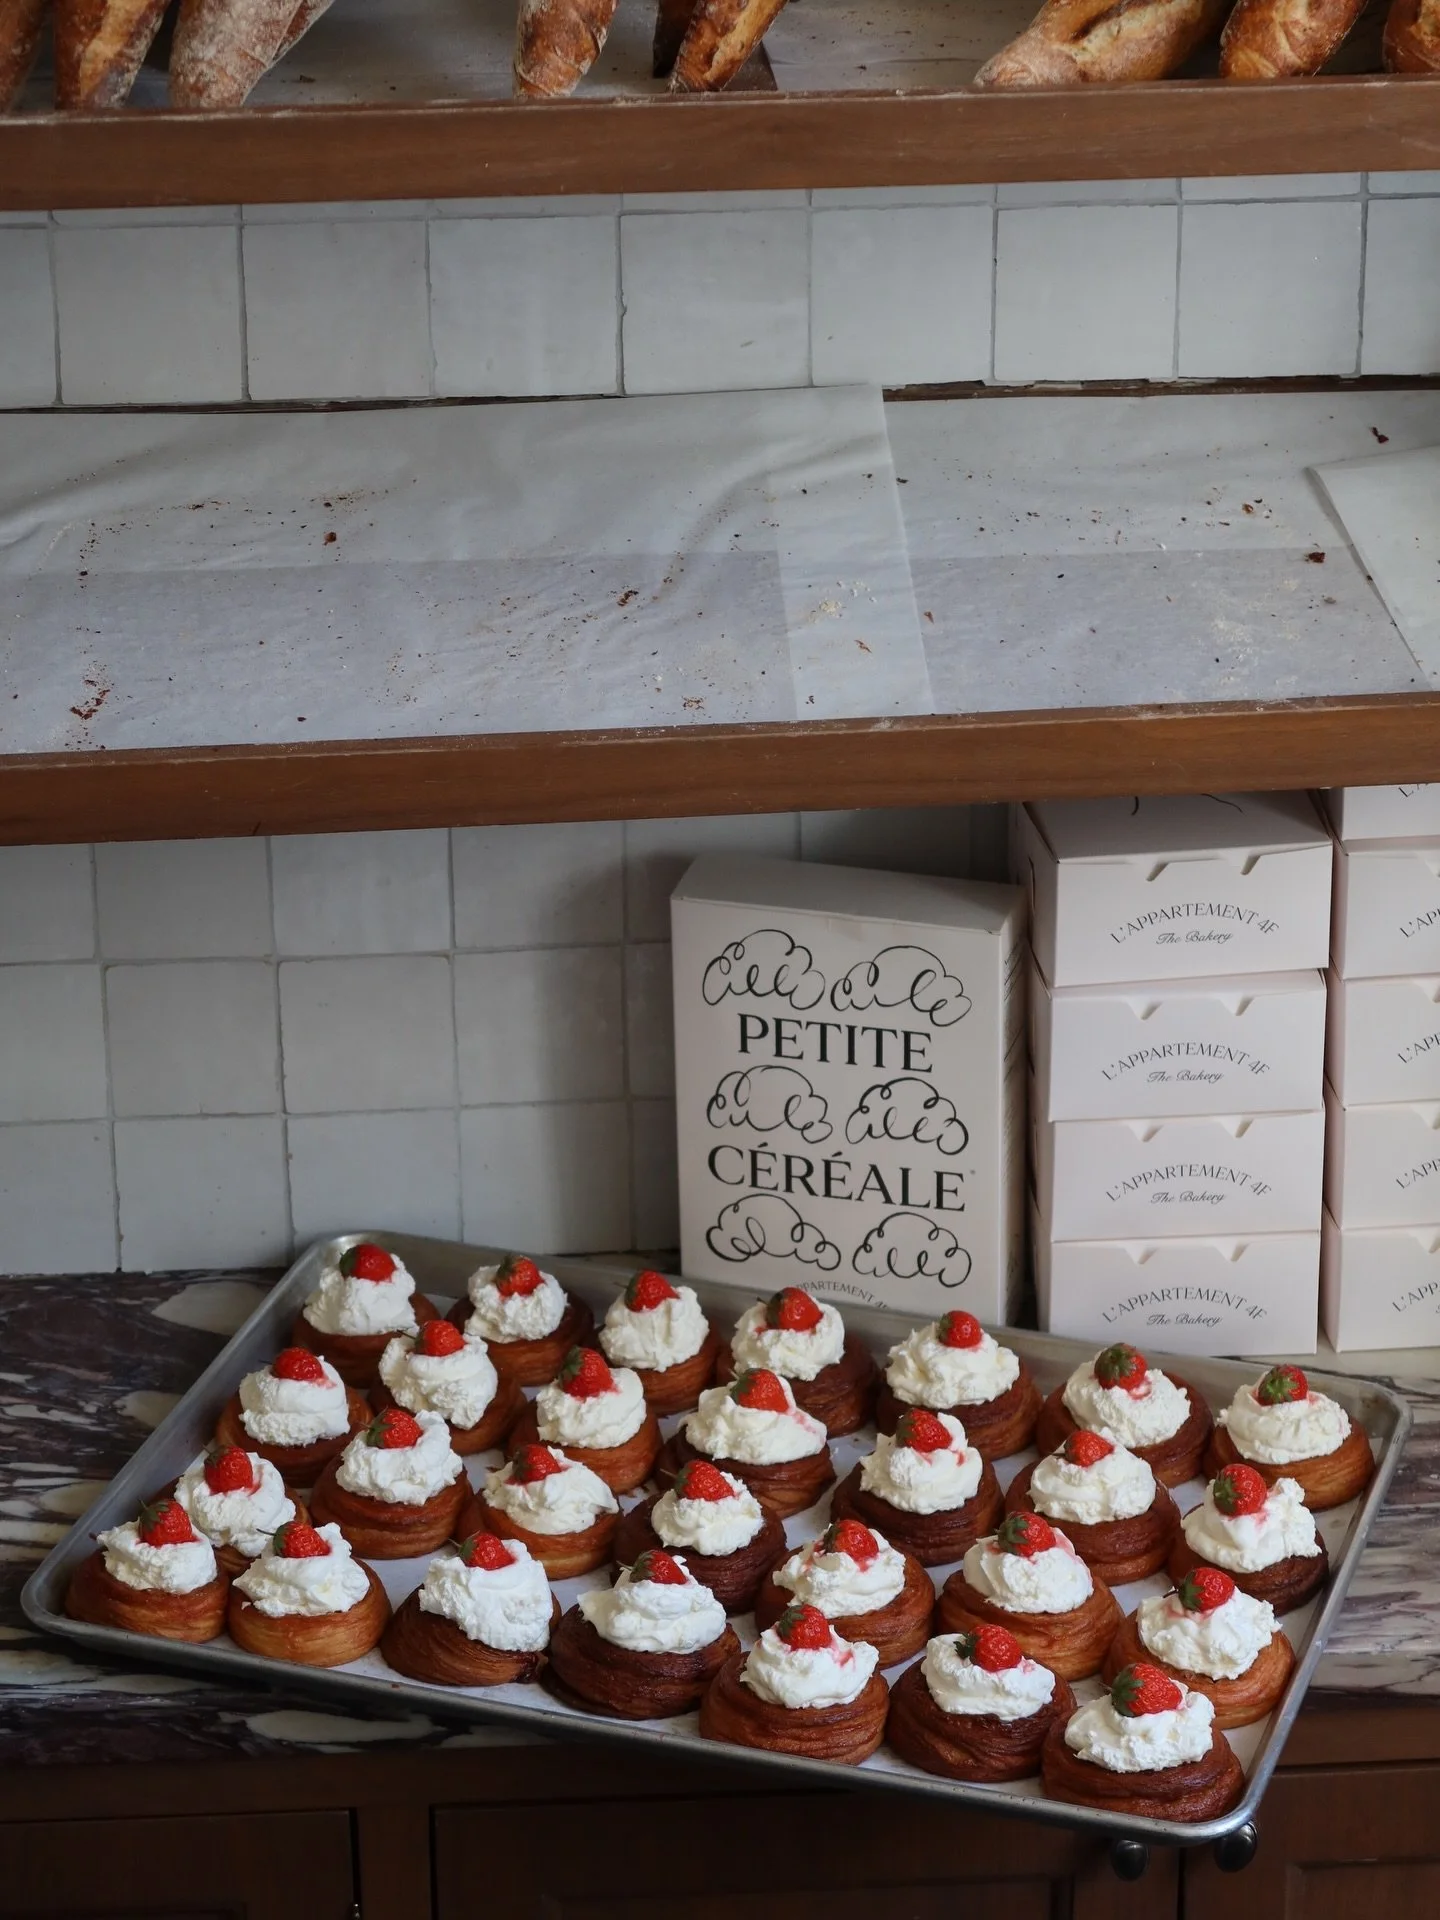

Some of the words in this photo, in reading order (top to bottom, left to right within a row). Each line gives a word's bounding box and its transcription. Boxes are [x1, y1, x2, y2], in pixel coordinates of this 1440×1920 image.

[1109, 902, 1260, 944] L'APPARTEMENT
[1256, 919, 1280, 935] 4F
[1156, 932, 1182, 945] The
[1185, 930, 1234, 945] Bakery
[737, 1012, 934, 1073] PETITE
[1101, 1042, 1251, 1081] L'APPARTEMENT
[1247, 1059, 1271, 1076] 4F
[1147, 1071, 1173, 1083] The
[1176, 1070, 1225, 1084] Bakery
[707, 1141, 966, 1213] CÉRÉALE
[1105, 1164, 1252, 1202] L'APPARTEMENT
[1250, 1182, 1272, 1197] 4F
[1151, 1191, 1175, 1204] The
[1179, 1190, 1227, 1205] Bakery
[1102, 1286, 1248, 1324] L'APPARTEMENT
[1243, 1304, 1268, 1320] 4F
[1146, 1313, 1171, 1326] The
[1175, 1312, 1223, 1328] Bakery
